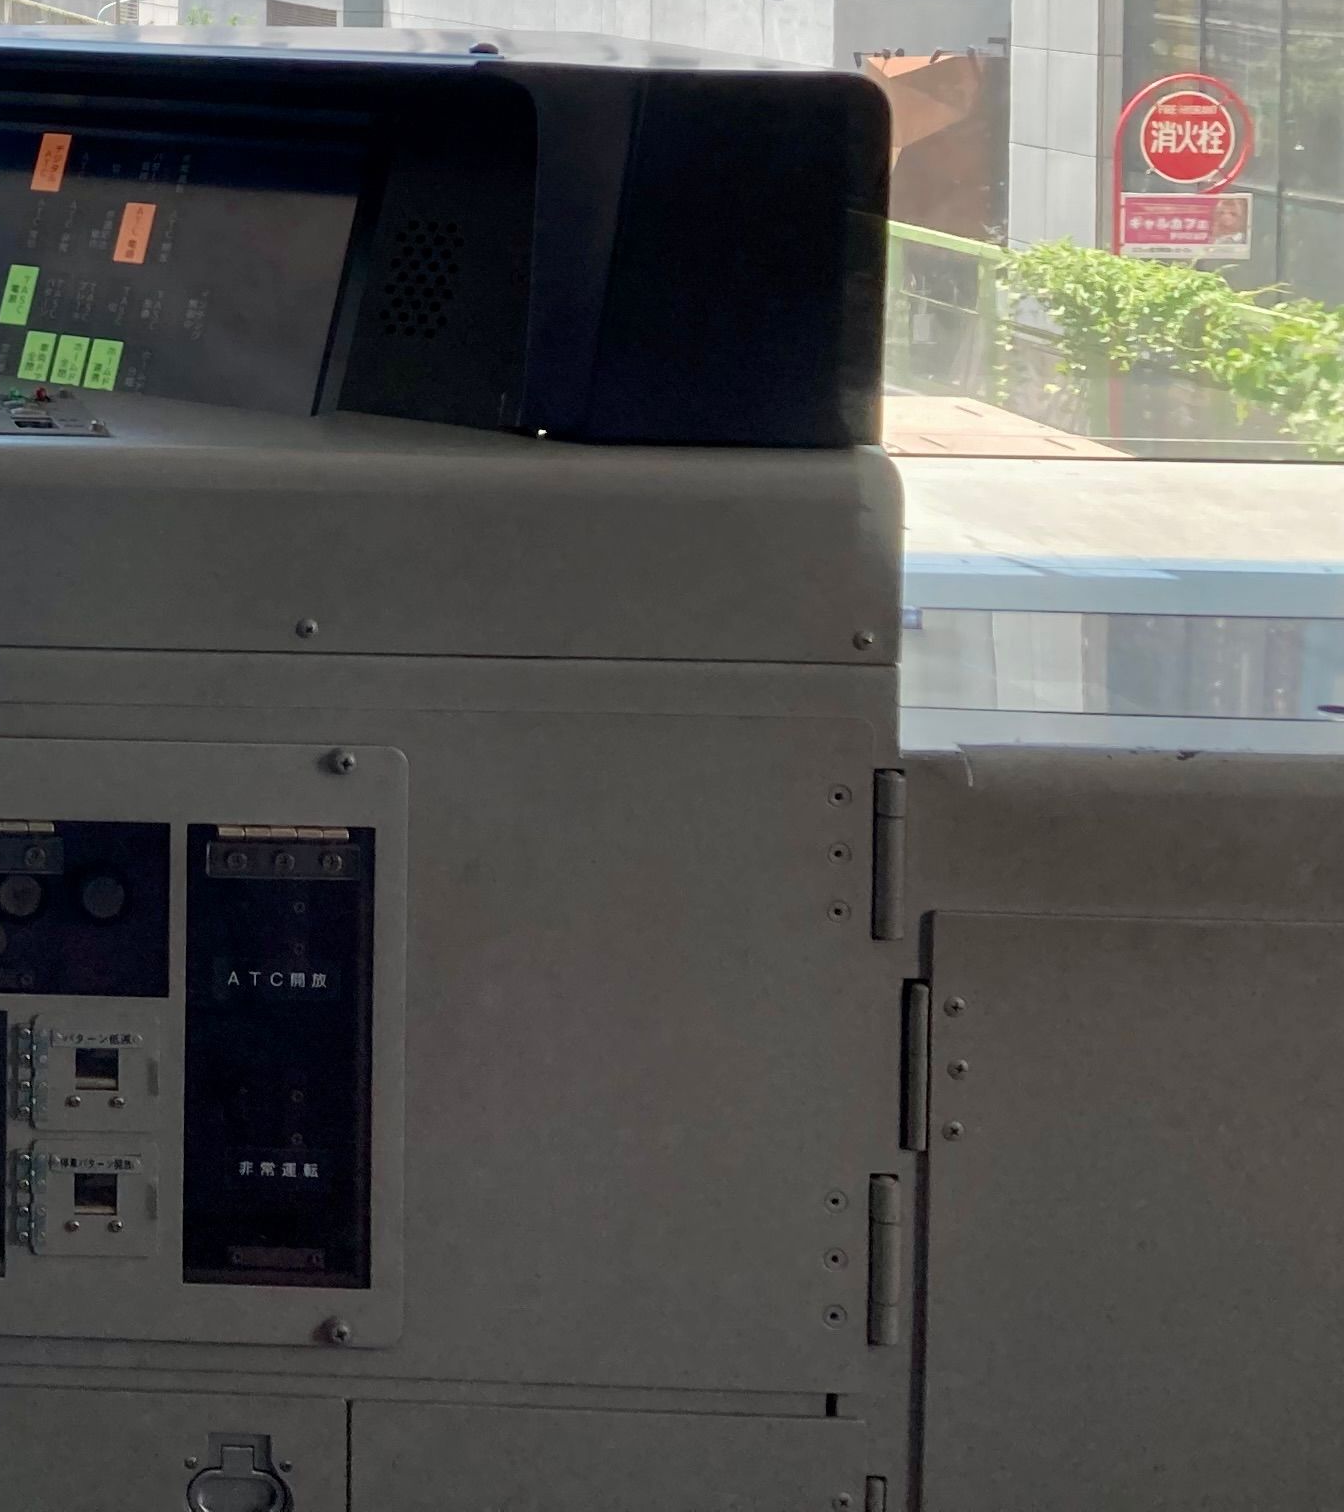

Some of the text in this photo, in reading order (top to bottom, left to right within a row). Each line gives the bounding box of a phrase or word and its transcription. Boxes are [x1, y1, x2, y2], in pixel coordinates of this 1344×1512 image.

[1149, 119, 1227, 155] 消火栓
[16, 274, 31, 315] TASC
[226, 970, 329, 990] ATC開放
[238, 1160, 320, 1179] 非常運転
